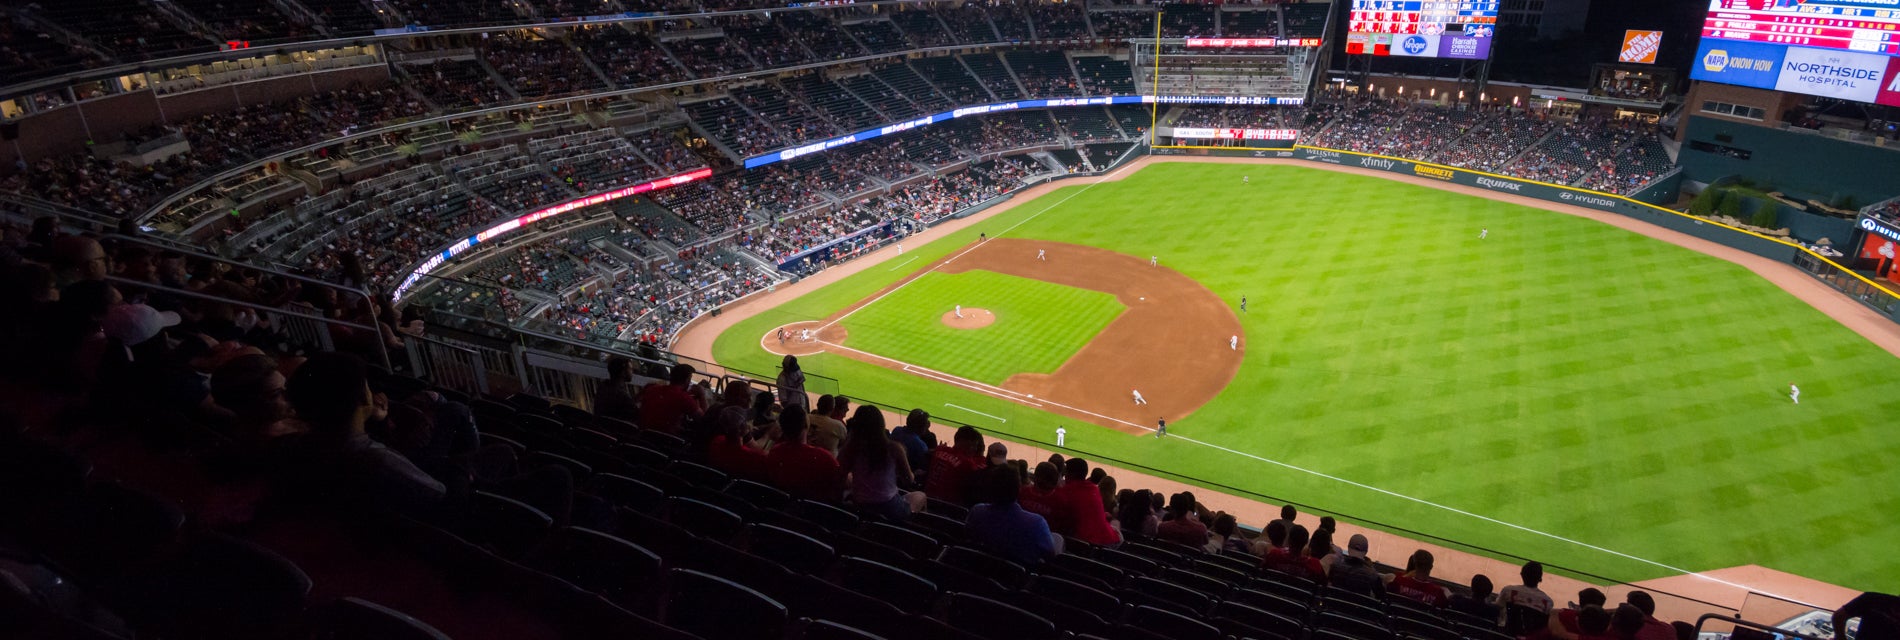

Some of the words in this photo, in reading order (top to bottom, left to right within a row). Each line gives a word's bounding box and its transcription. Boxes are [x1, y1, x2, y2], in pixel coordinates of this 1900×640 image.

[1727, 20, 1757, 30] PHILLIES
[1724, 31, 1750, 39] BRAVES
[1404, 38, 1425, 53] Kroger
[1620, 31, 1661, 61] HOME
[1634, 44, 1657, 61] DEPOT
[1706, 54, 1726, 67] NAPA
[1729, 57, 1753, 70] KNOW
[1753, 59, 1774, 72] HOW
[1786, 61, 1879, 81] NORTHSIDE
[1799, 74, 1857, 89] HOSPITAL
[1360, 156, 1395, 170] xfinity
[1414, 164, 1454, 177] QUIKRETE
[1476, 177, 1522, 191] EQUIFAX
[1574, 194, 1616, 208] HYUNDAI
